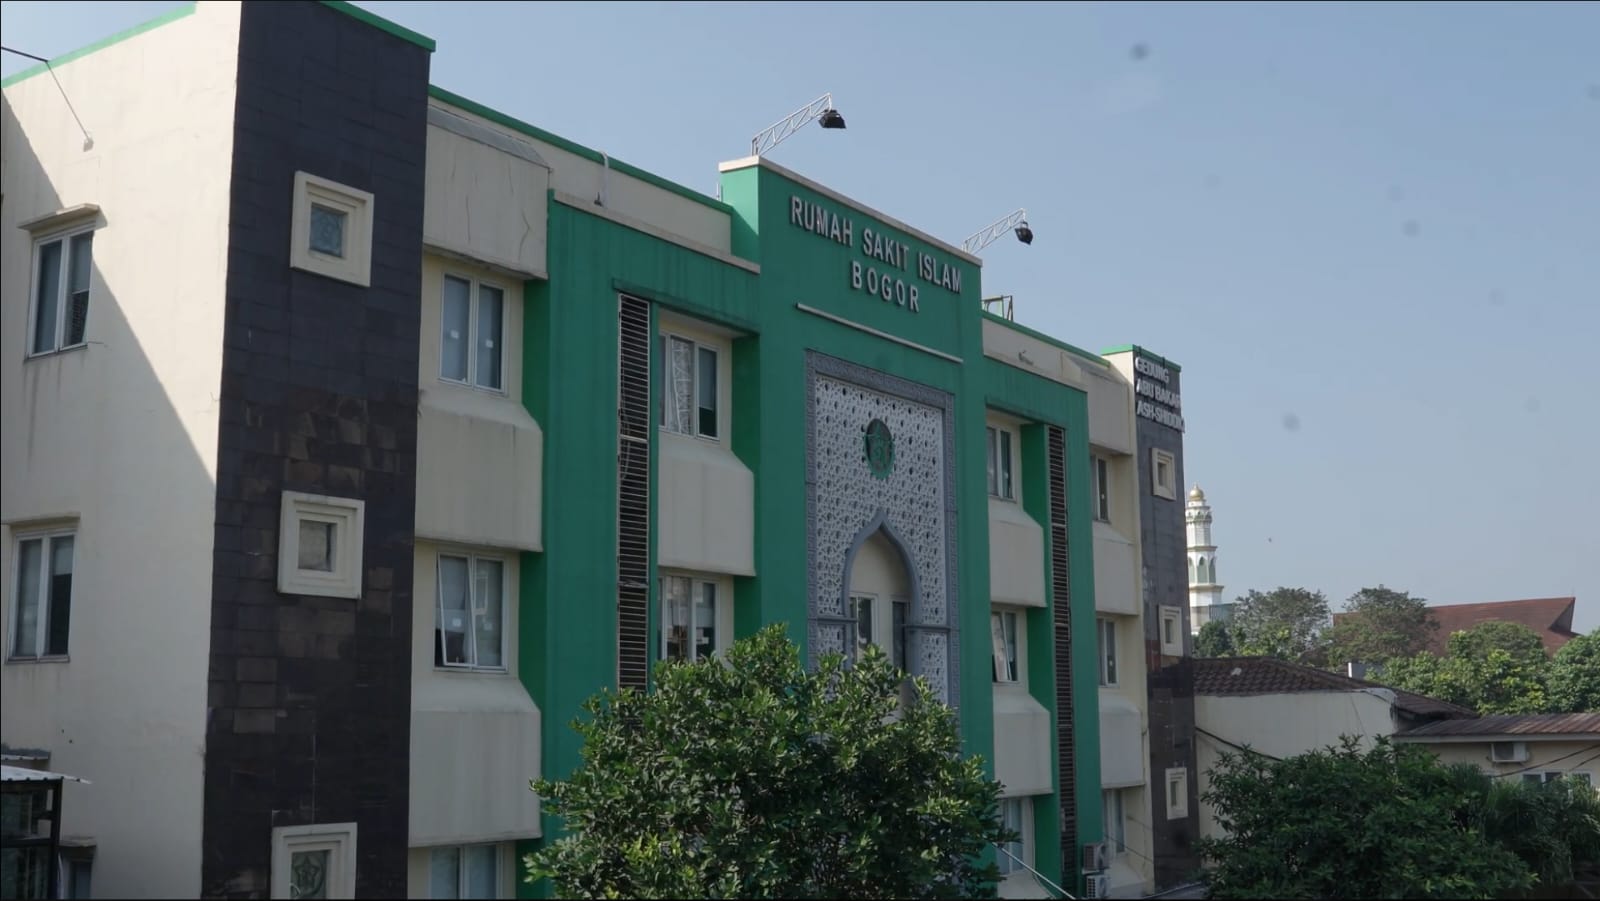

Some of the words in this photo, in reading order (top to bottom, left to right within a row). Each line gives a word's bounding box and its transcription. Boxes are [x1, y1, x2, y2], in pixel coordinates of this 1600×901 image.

[791, 195, 853, 247] RUMAH
[863, 228, 909, 271] SAKIT
[918, 252, 962, 294] ISLAM
[851, 260, 919, 313] BOGOR
[1135, 356, 1170, 383] GEDUNG
[1136, 378, 1154, 398] ABU
[1155, 385, 1181, 409] BAKAR
